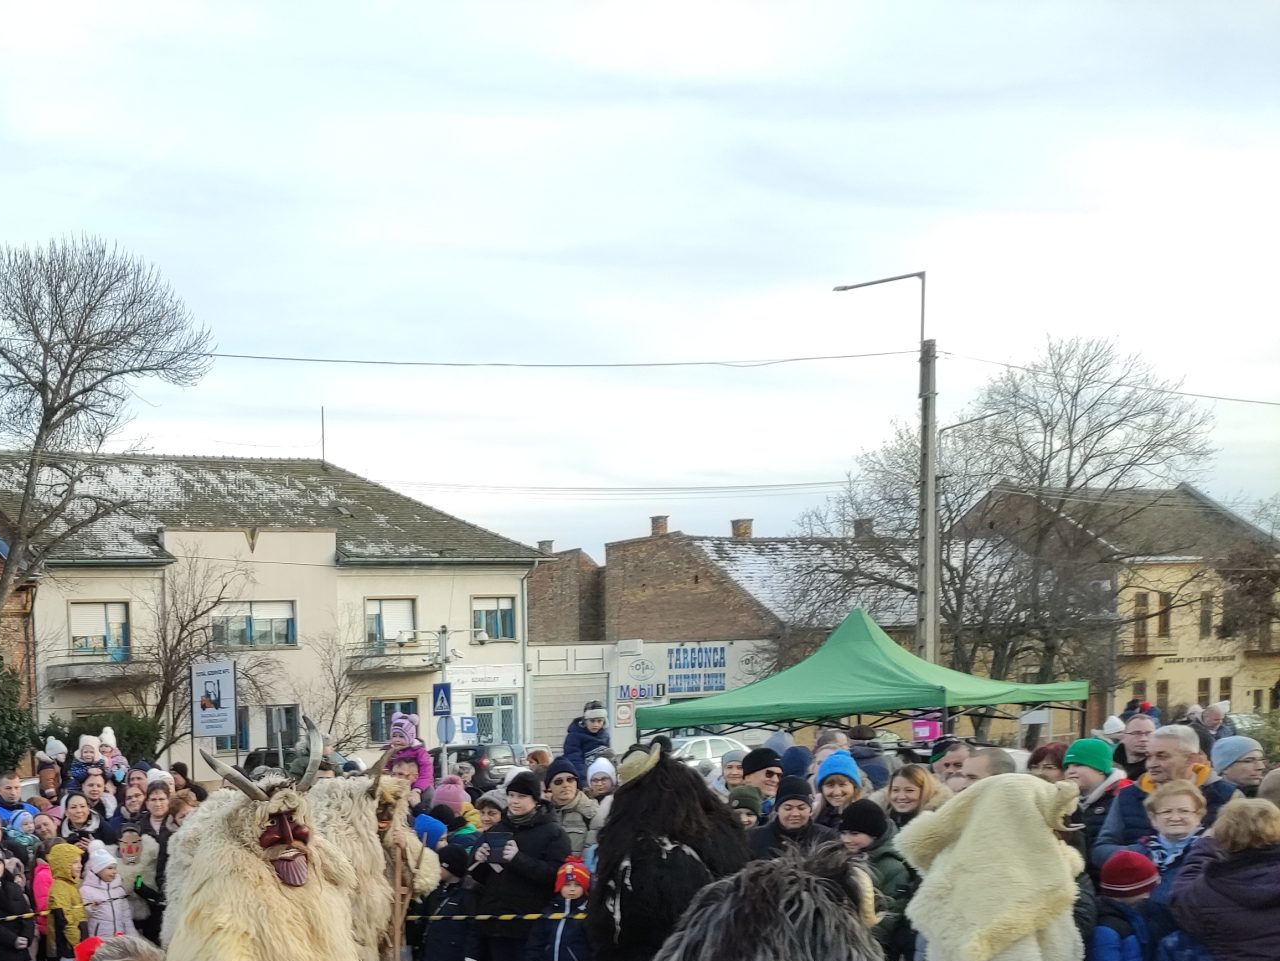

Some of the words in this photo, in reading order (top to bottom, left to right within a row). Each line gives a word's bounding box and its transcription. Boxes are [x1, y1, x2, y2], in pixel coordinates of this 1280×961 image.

[668, 647, 725, 669] TARGONCA
[620, 684, 654, 699] Mobil
[462, 718, 474, 732] P
